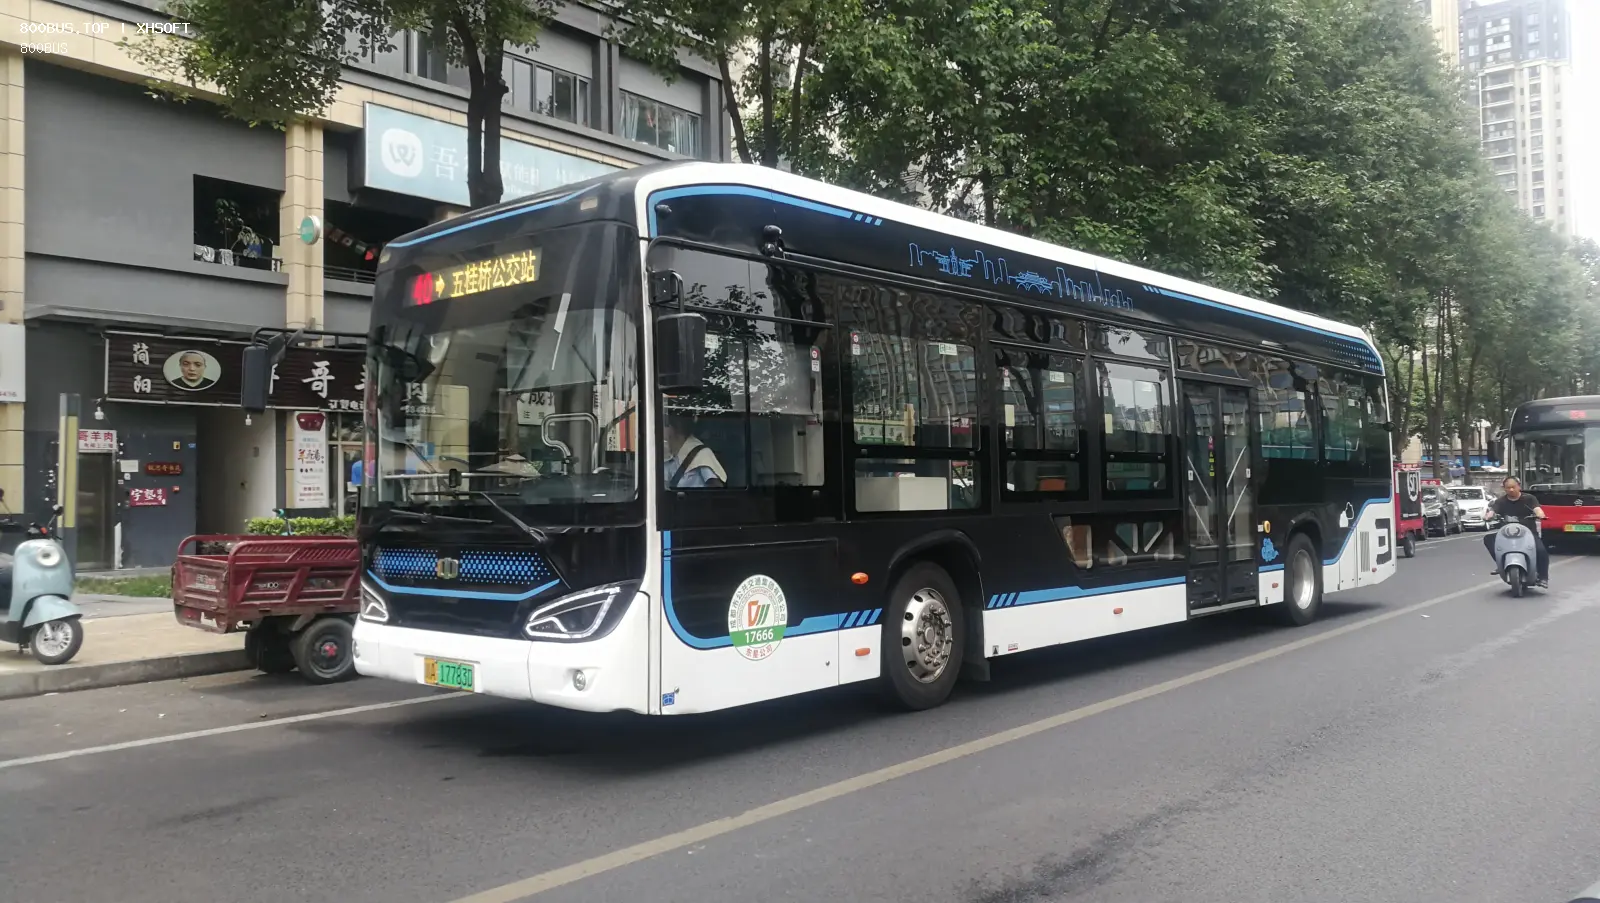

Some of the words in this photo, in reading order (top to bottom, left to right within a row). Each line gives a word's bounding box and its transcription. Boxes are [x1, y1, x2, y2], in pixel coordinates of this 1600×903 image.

[450, 249, 536, 298] 五桂桥公交站
[132, 342, 152, 394] 简阳
[745, 628, 774, 644] 17666
